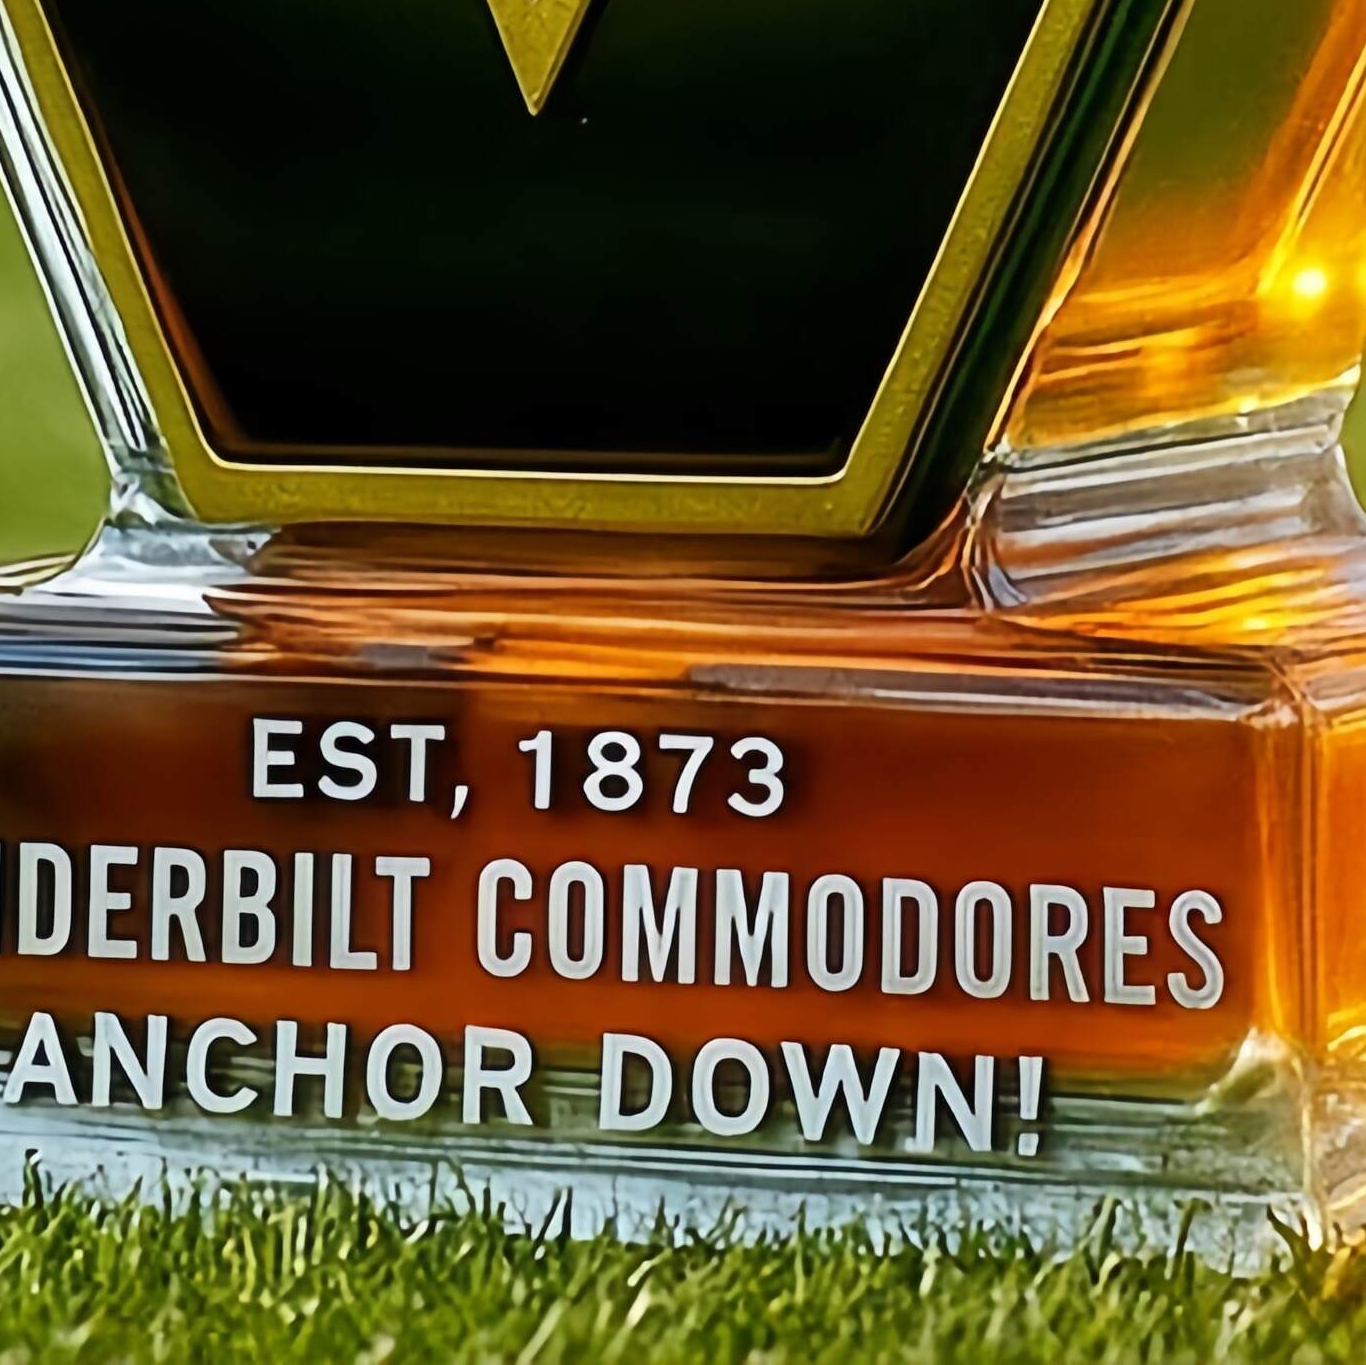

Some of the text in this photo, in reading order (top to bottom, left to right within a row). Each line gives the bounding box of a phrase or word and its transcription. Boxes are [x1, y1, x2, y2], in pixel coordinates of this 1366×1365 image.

[252, 717, 786, 820] EST, 1873
[476, 857, 1225, 1010] COMMODORES
[2, 1011, 1044, 1157] ANCHOR DOWN!
